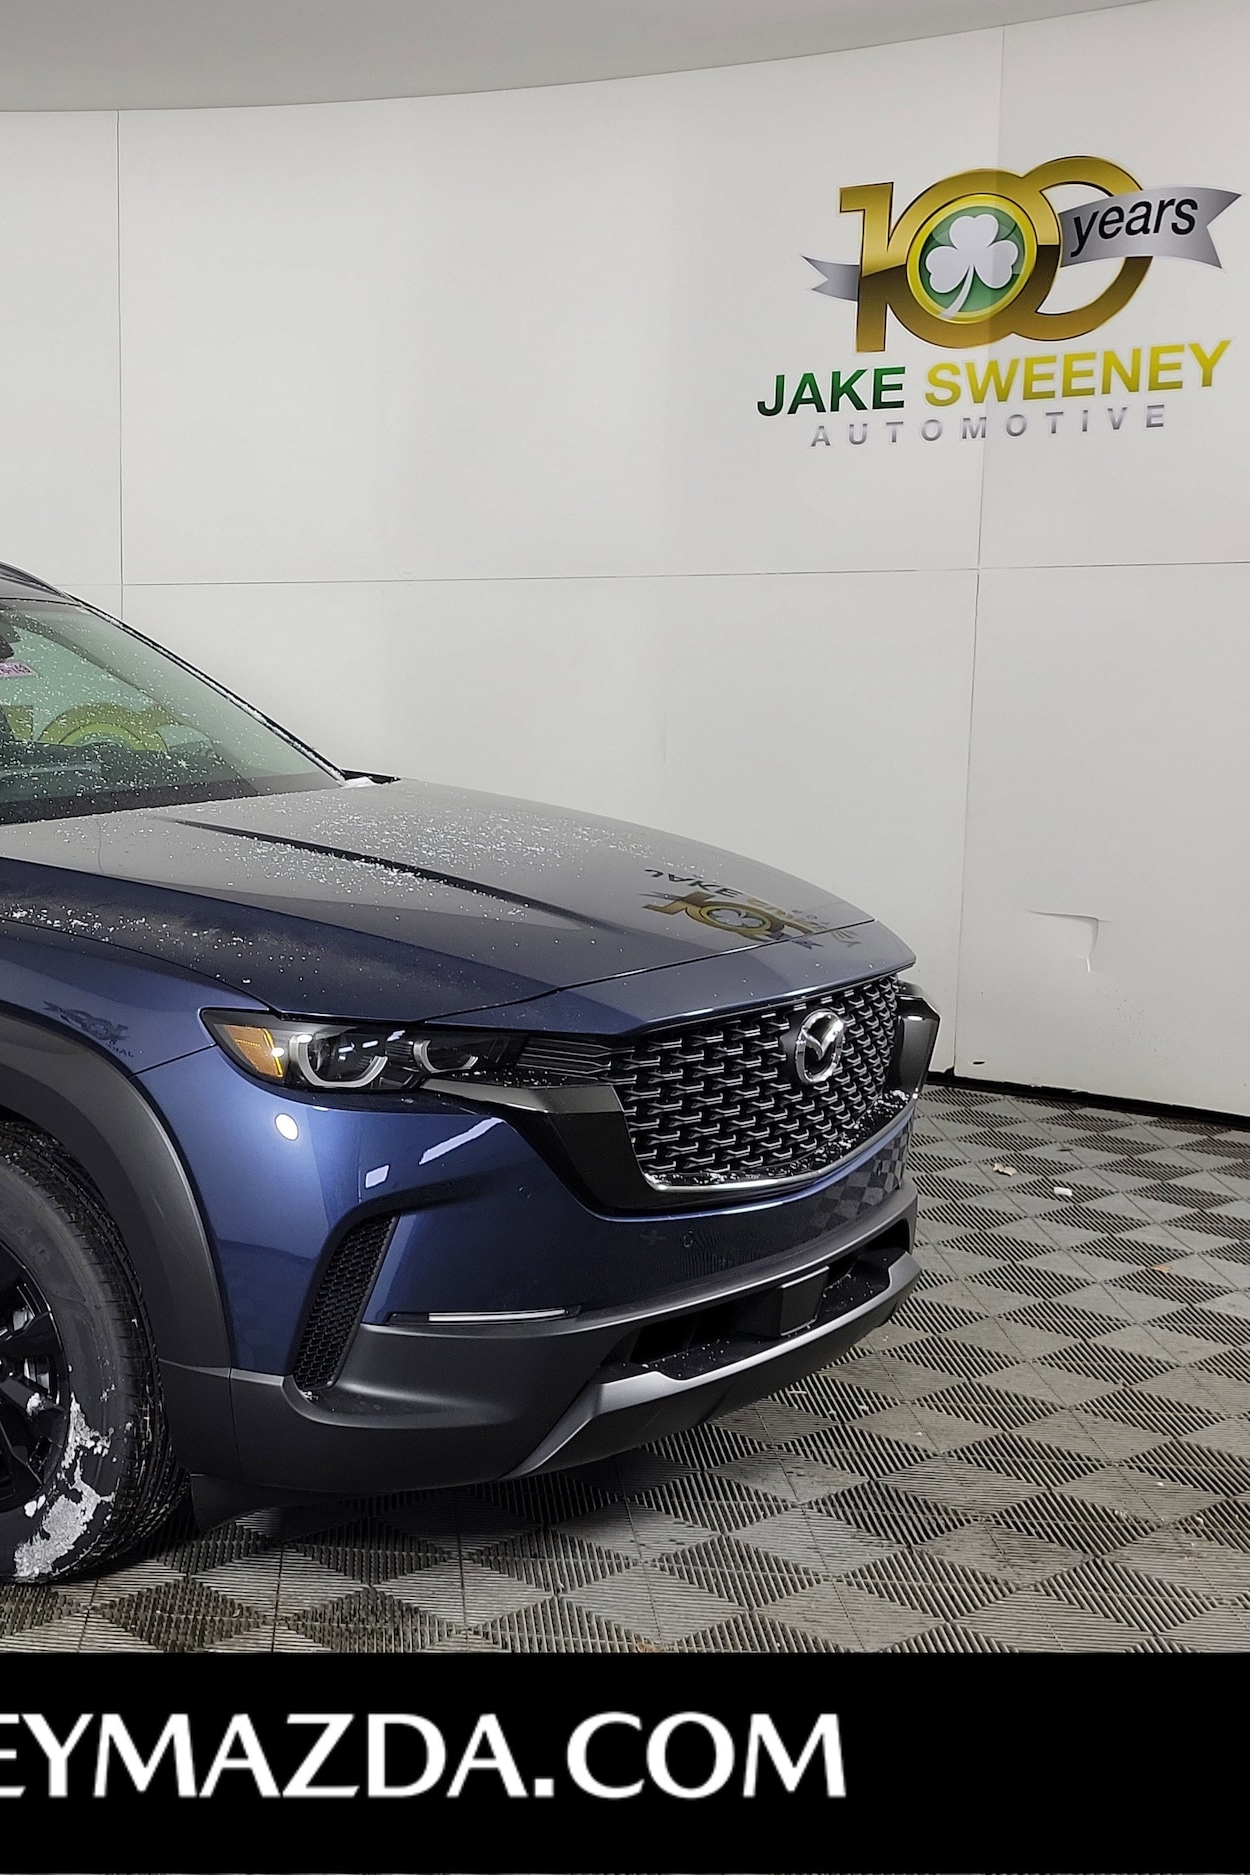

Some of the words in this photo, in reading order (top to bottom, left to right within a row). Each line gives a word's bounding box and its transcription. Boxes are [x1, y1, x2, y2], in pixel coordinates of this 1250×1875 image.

[839, 155, 1153, 353] 100
[1069, 197, 1197, 257] years
[757, 366, 906, 417] JAKE
[925, 339, 1232, 407] SWEENEY
[810, 404, 1165, 447] AUTOMOTIVE
